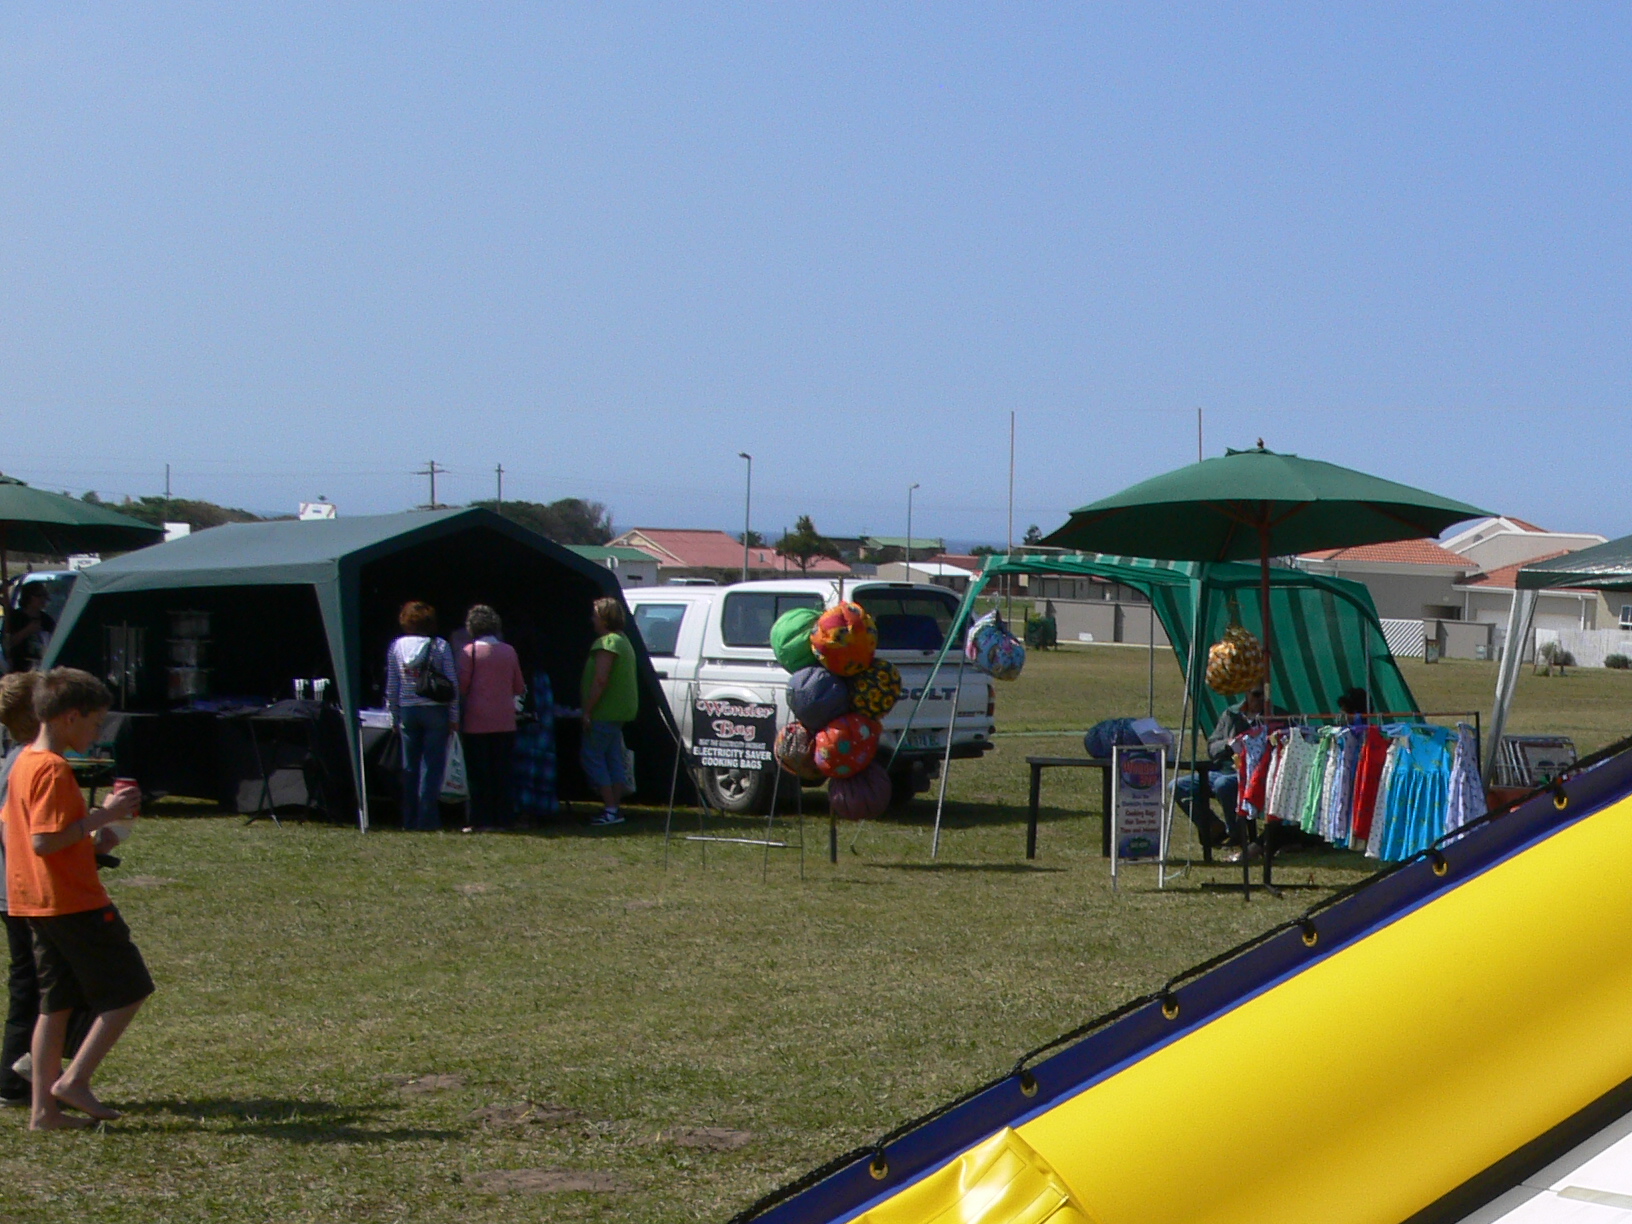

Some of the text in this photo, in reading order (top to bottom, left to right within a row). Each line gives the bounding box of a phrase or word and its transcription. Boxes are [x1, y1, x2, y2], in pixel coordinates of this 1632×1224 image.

[898, 687, 956, 701] COLT
[695, 700, 775, 719] Wonder
[711, 719, 756, 742] Bag
[693, 746, 772, 760] ELECTRICITY SAVER
[702, 757, 762, 770] COOKING BAGS
